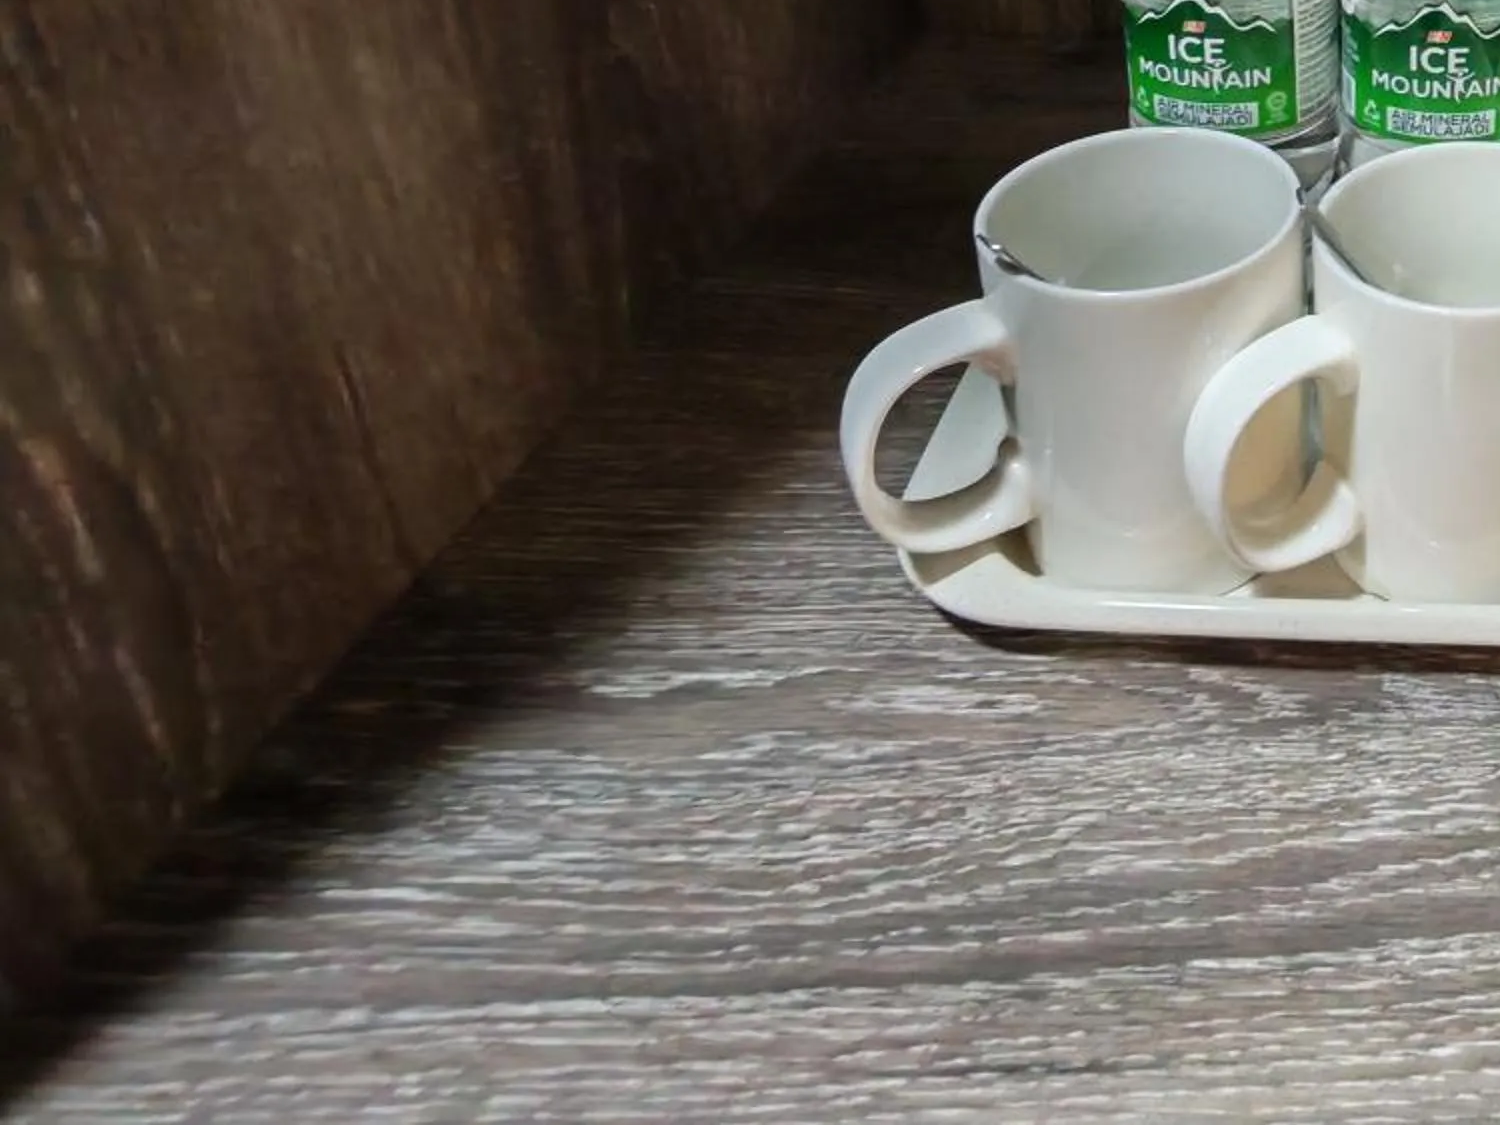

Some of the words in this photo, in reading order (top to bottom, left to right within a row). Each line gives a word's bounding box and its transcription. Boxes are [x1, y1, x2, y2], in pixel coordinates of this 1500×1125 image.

[1167, 33, 1226, 64] ICE
[1408, 45, 1471, 75] ICE
[1139, 55, 1272, 94] MOUNTAIN
